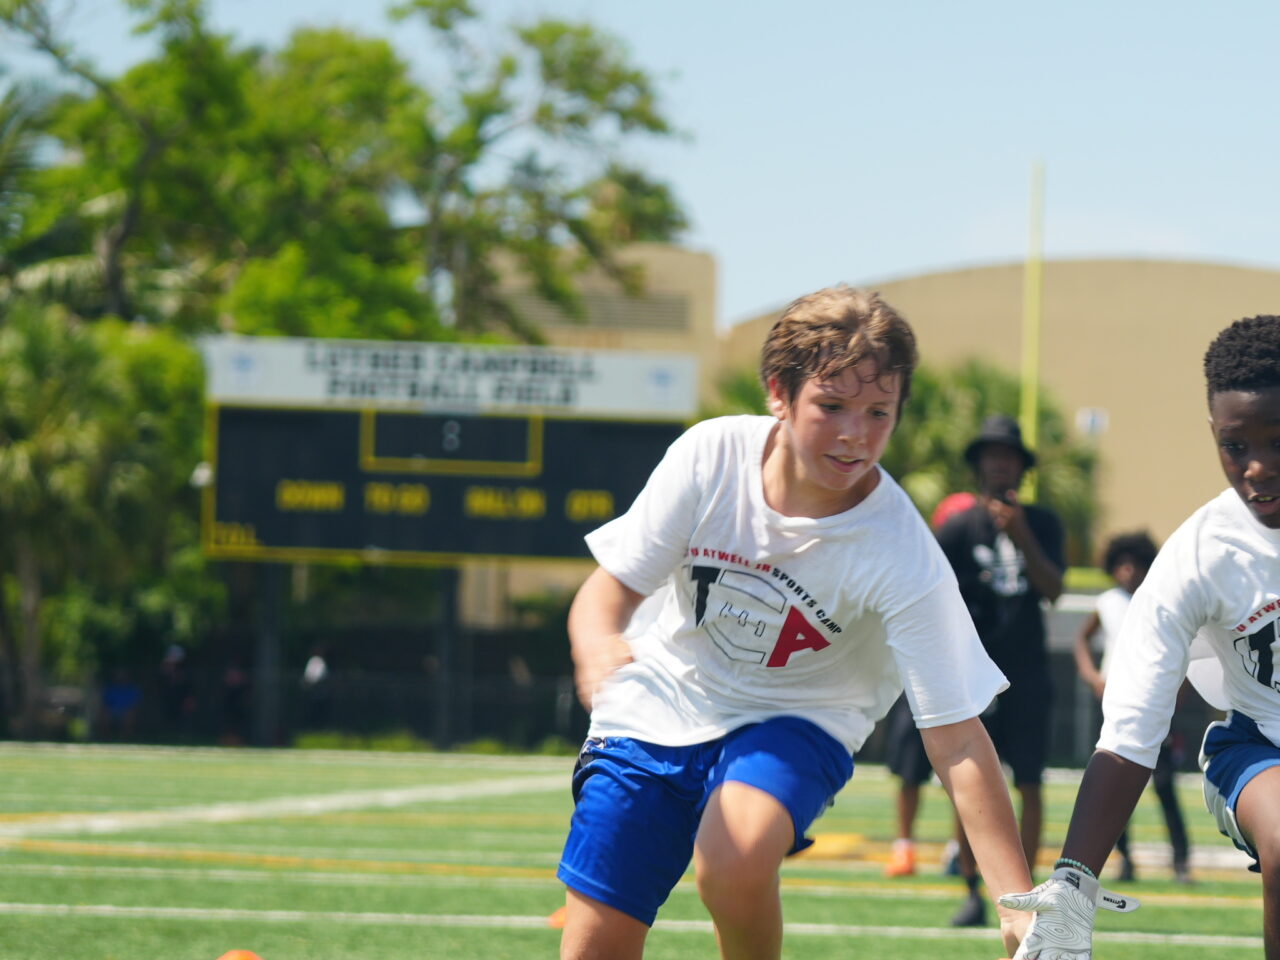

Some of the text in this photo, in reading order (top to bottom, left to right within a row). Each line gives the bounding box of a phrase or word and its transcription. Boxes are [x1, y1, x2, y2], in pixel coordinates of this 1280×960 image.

[703, 548, 750, 568] ATWELL
[772, 568, 818, 608] SPORTS
[815, 608, 843, 635] CAMP
